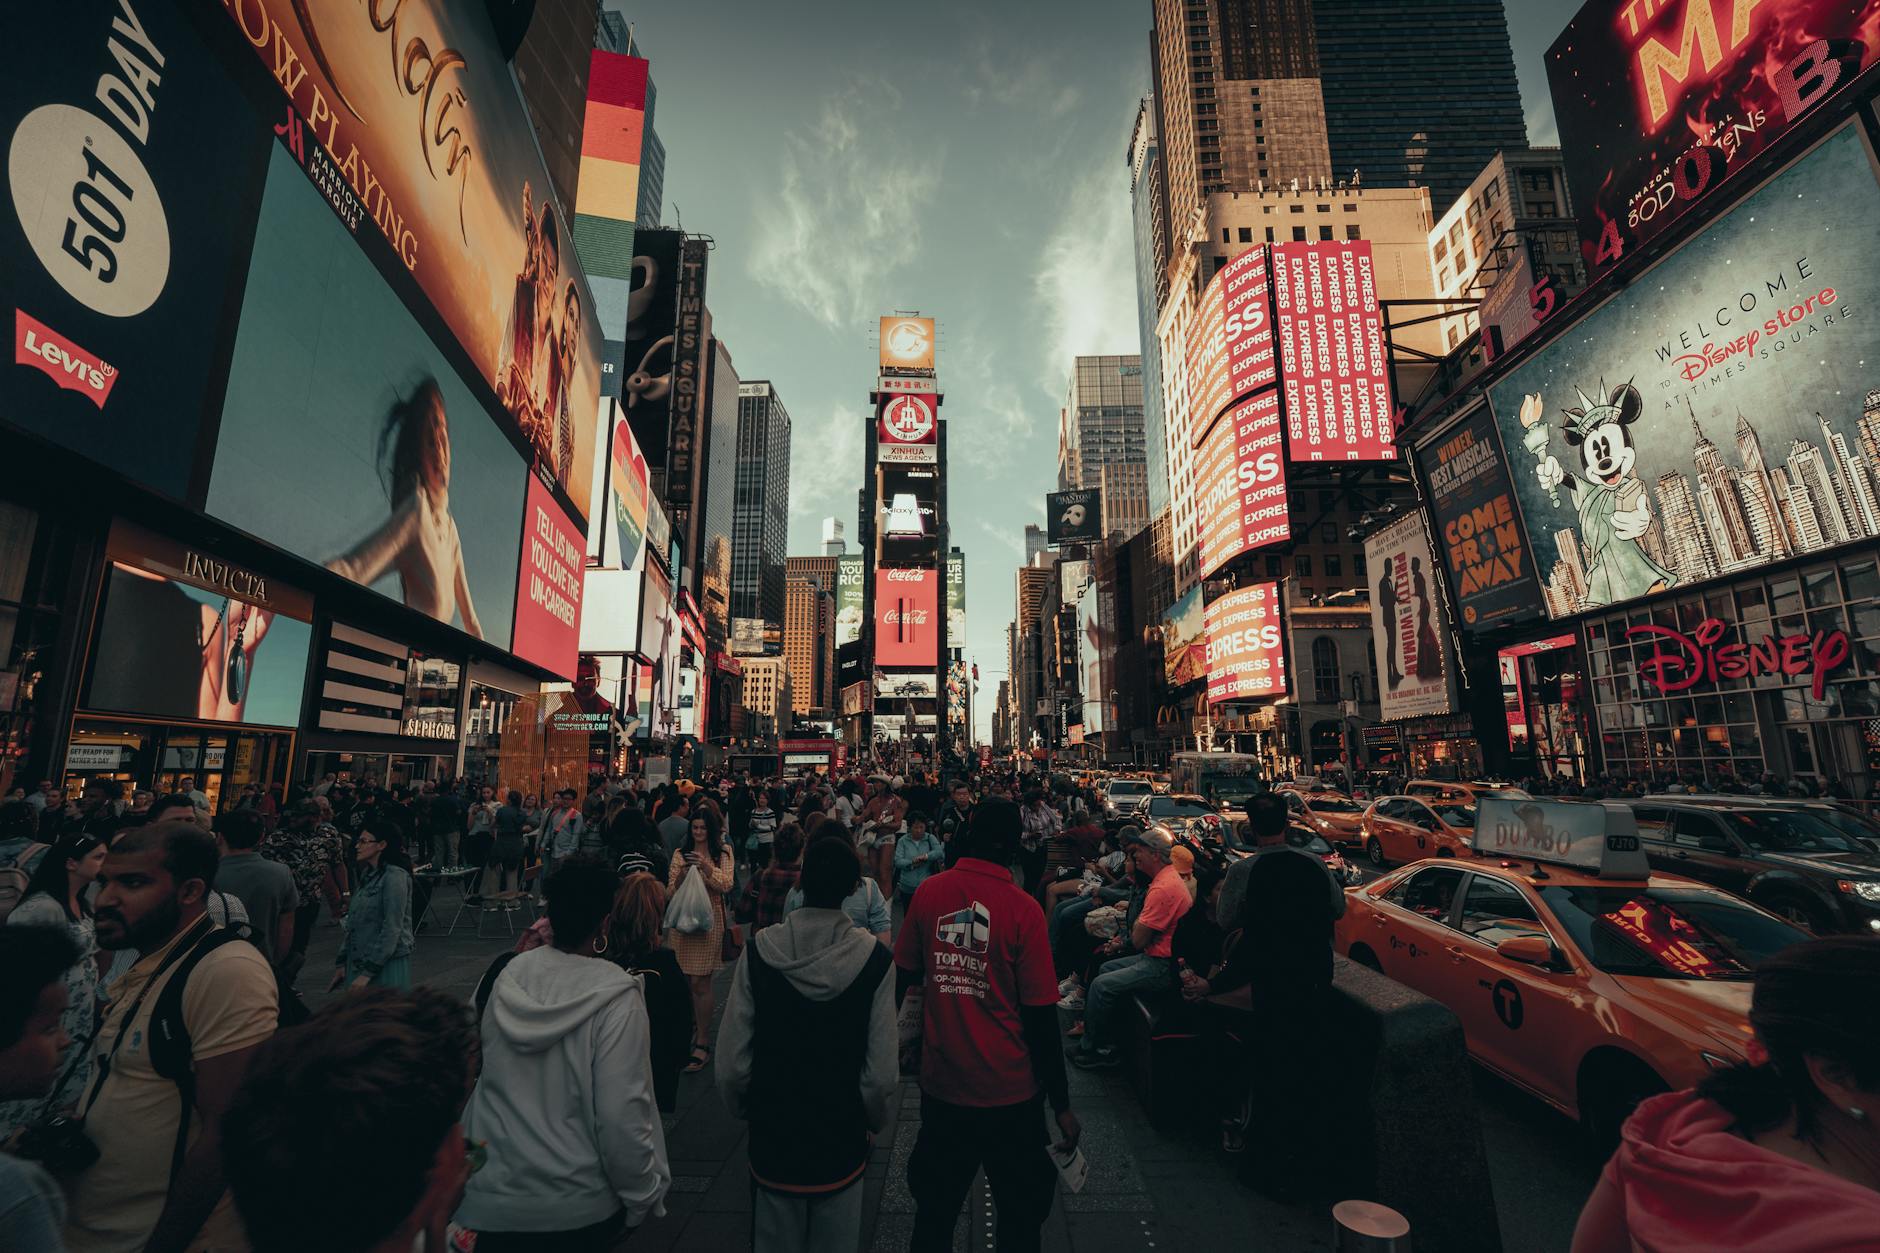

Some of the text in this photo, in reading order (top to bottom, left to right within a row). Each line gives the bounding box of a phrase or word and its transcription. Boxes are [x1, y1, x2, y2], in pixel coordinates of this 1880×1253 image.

[232, 0, 418, 271] OW PLAYING
[310, 164, 358, 234] MARQUIS
[313, 146, 366, 222] MARRIOTT
[1629, 166, 1671, 207] AMAZON
[62, 146, 134, 283] 501
[682, 262, 702, 349] TIMES
[1292, 258, 1308, 314] EXPRESS
[1326, 257, 1342, 313] EXPRESS
[1359, 256, 1375, 312] EXPRESS
[1655, 257, 1813, 362] WELCOME
[1764, 287, 1839, 336] store
[1189, 302, 1264, 397] EXPRESS
[1275, 253, 1302, 439] EXPRESS EXPRESS EXPRESS
[1298, 320, 1314, 378] EXPRESS
[1308, 252, 1337, 439] EXPRESS EXPRESS EXPRESS
[1333, 319, 1349, 377] EXPRESS
[1342, 251, 1373, 438] EXPRESS EXPRESS EXPRESS
[1366, 319, 1383, 376] EXPRESS
[1664, 304, 1852, 410] AT TIMES SQUARE
[1374, 383, 1391, 443] EXPRESS
[1660, 380, 1671, 390] TO
[673, 360, 696, 472] SQUARE
[1304, 385, 1320, 445] EXPRESS
[1340, 384, 1356, 444] EXPRESS
[891, 447, 925, 456] XINHUA
[904, 454, 933, 462] AGENCY
[1430, 462, 1452, 490] BEST
[1451, 437, 1496, 477] MUSICAL
[1198, 453, 1279, 527] EXPRESS
[537, 506, 555, 548] TELL
[555, 529, 565, 558] US
[565, 536, 581, 573] WHY
[1444, 493, 1513, 546] COME
[183, 551, 267, 600] INVICTA
[531, 536, 580, 603] YOU LOVE THE
[887, 568, 926, 582] Coca-Cola
[1393, 551, 1411, 605] PRETTY
[1460, 547, 1522, 597] AWAY
[530, 573, 575, 628] UN-CARRIER
[1222, 589, 1265, 609] EXPRESS
[1223, 607, 1266, 626] EXPRESS
[1206, 625, 1280, 664] EXPRESS
[1227, 659, 1270, 675] EXPRESS
[1400, 615, 1418, 676] WOMAN
[1228, 677, 1273, 692] EXPRESS
[407, 718, 456, 740] SEPHORA
[934, 951, 988, 974] TOPVIEW
